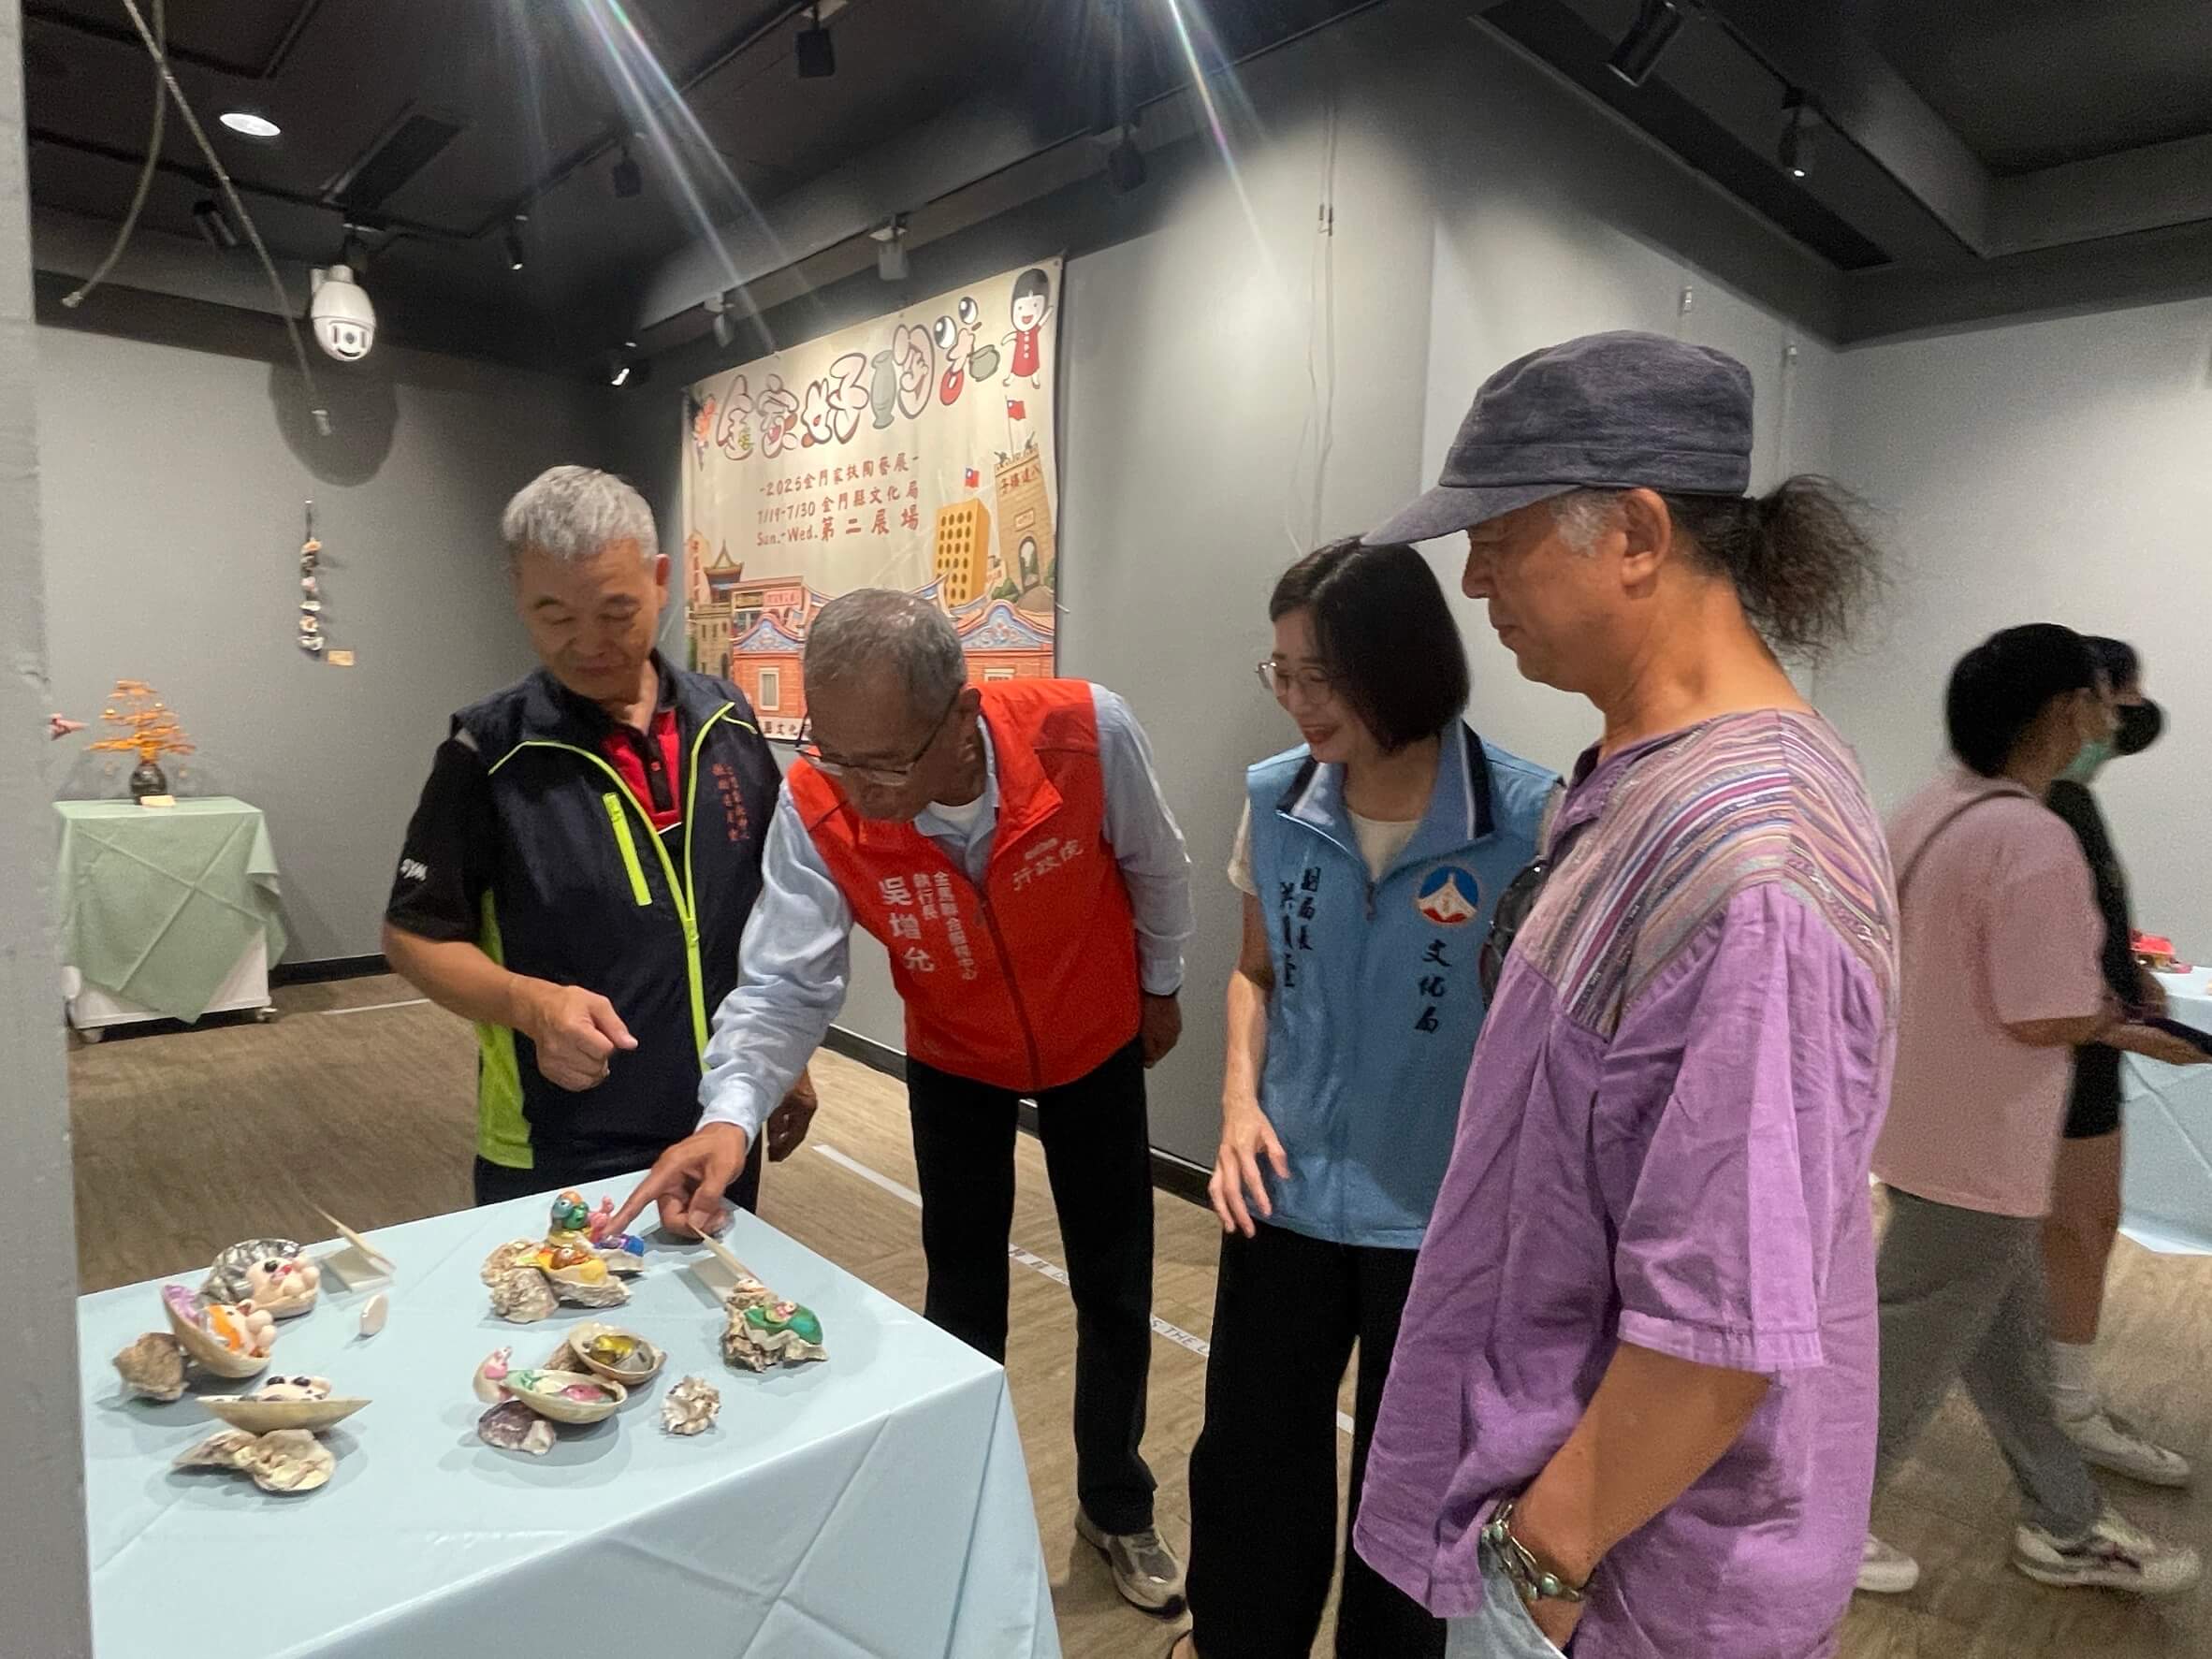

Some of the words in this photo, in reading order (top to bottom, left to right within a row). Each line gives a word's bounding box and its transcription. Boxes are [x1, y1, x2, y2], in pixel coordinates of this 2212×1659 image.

[821, 480, 919, 514] 金門縣文化局
[821, 503, 919, 542] 第二展場
[879, 875, 935, 972] 吳增允
[1415, 939, 1452, 1034] 文化局
